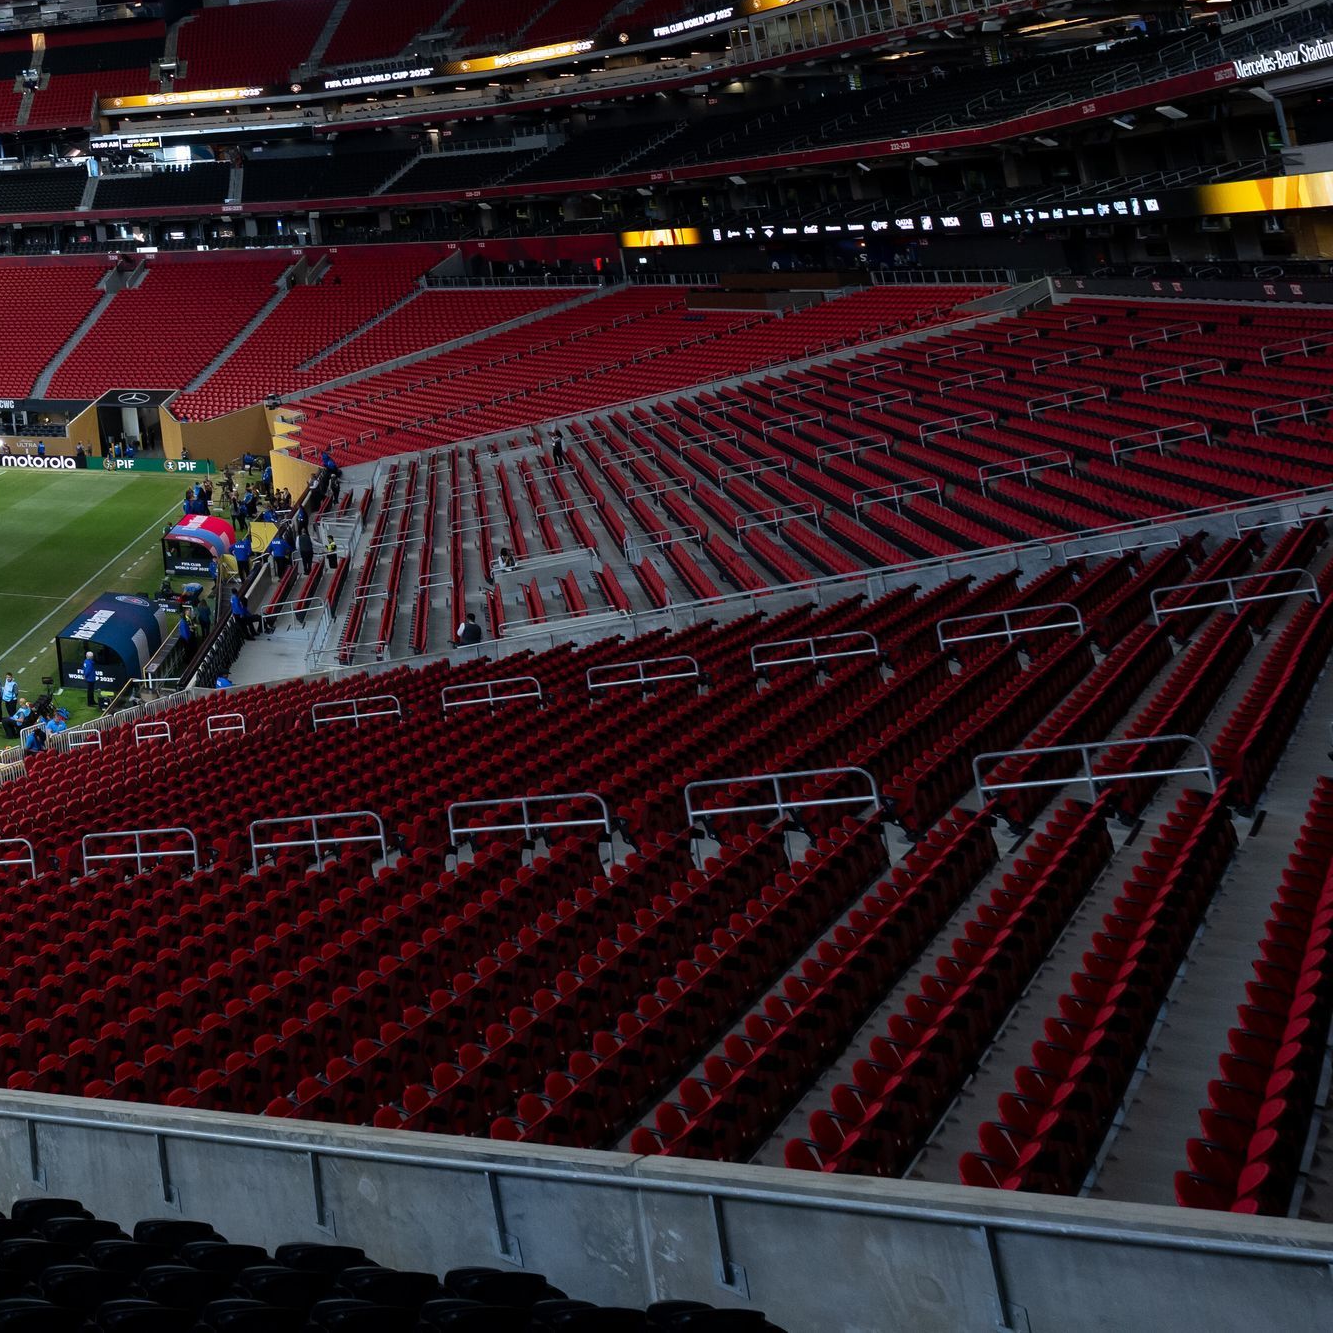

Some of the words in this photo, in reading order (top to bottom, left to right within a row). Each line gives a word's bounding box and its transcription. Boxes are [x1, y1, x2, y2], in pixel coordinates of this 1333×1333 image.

[1233, 50, 1300, 79] Mercedes-Benz
[325, 79, 341, 89] FIFA
[343, 76, 361, 86] CLUB
[363, 73, 391, 84] WORLD
[393, 71, 407, 80] CUP
[2, 456, 76, 468] motorola
[117, 460, 134, 468] PIF
[178, 462, 196, 471] PIF
